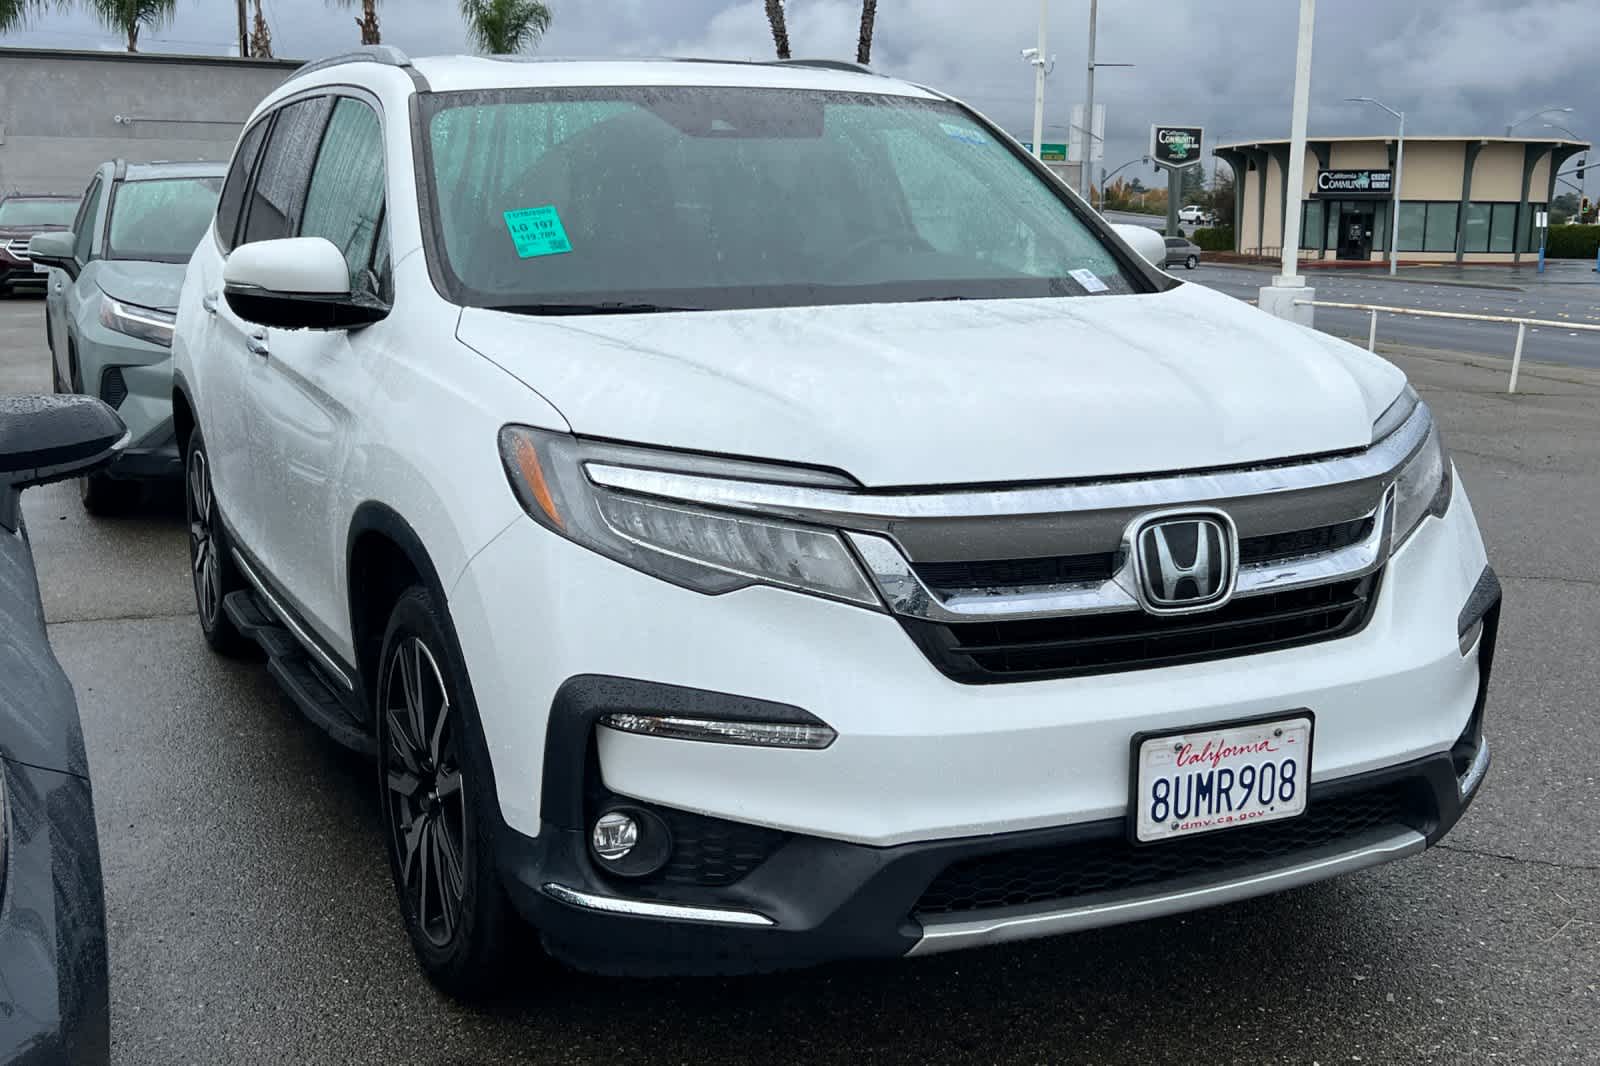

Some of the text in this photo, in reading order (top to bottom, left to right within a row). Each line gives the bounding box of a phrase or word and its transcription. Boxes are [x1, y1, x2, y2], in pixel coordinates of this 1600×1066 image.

[533, 220, 553, 230] 197
[1176, 738, 1280, 768] California
[1151, 758, 1297, 824] 8UMR908
[1180, 810, 1265, 831] dmv.ca.gov
